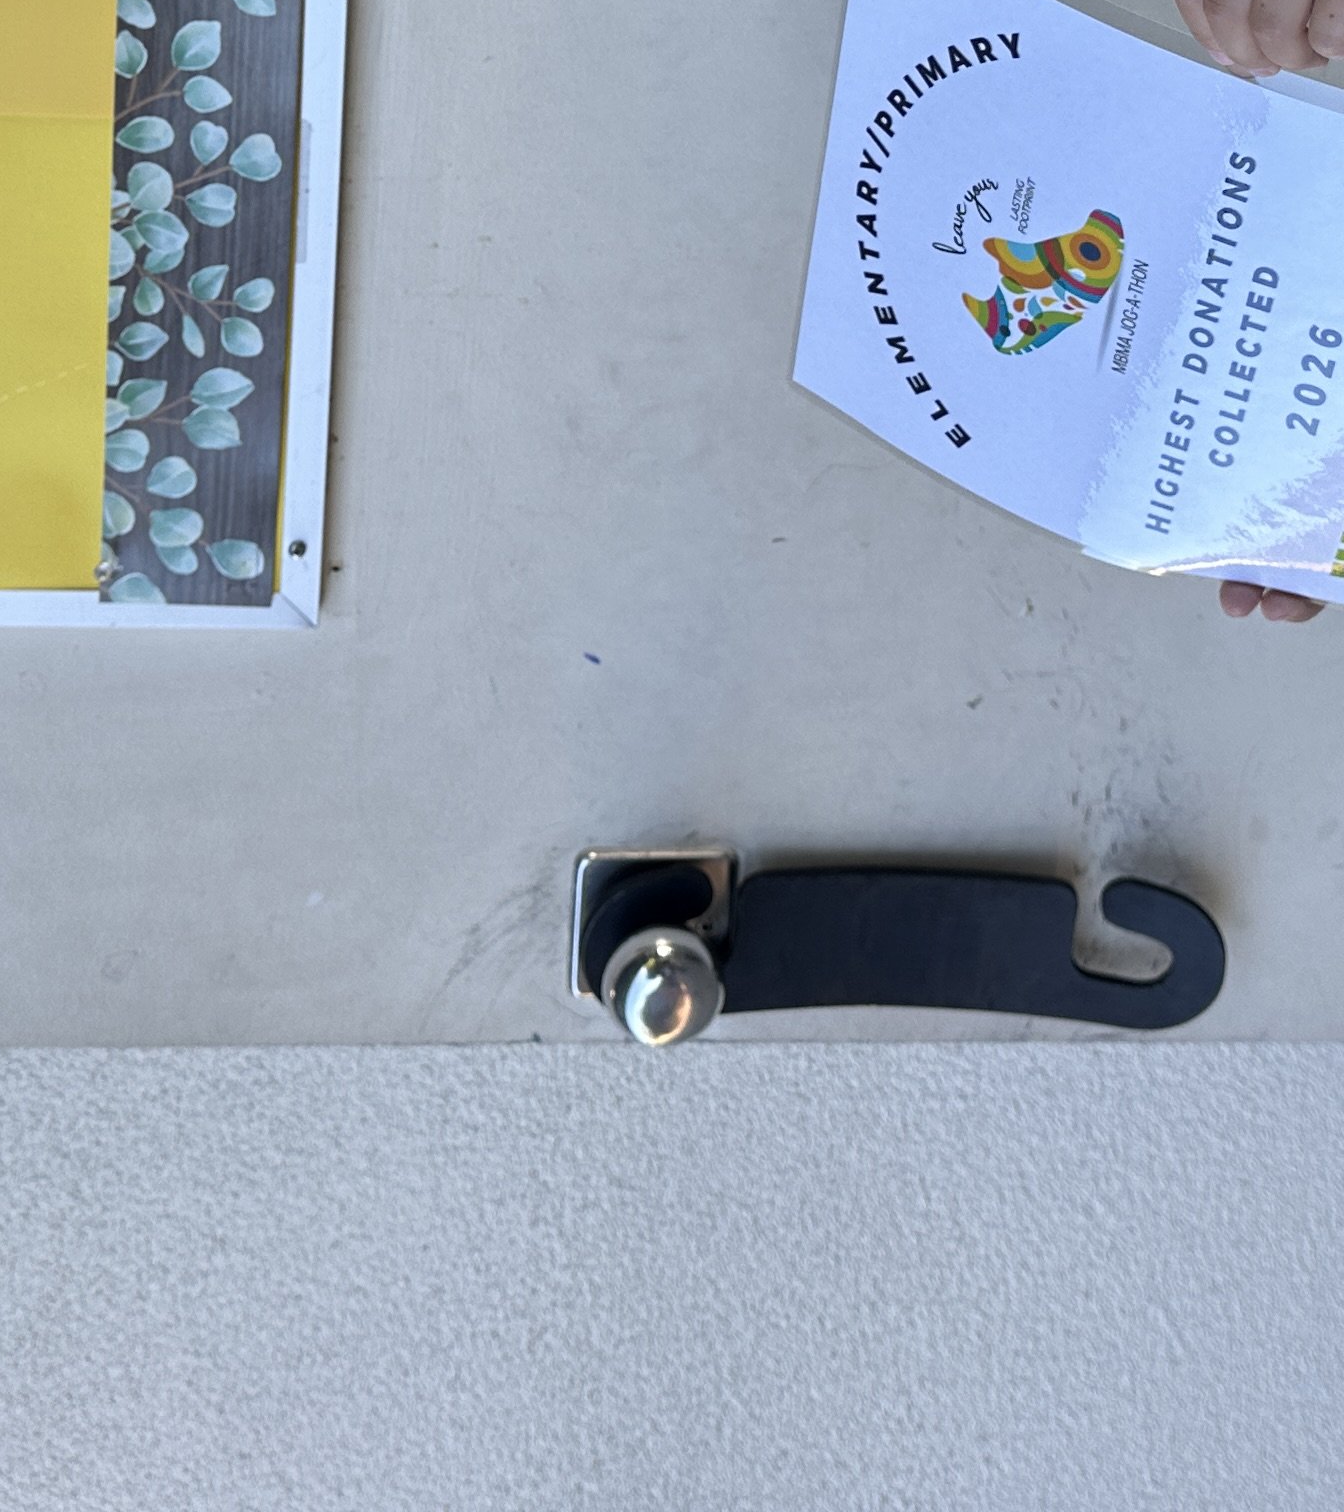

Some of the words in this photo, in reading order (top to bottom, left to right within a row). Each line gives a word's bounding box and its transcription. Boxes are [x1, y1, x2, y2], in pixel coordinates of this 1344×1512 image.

[932, 203, 967, 255] leave
[964, 178, 999, 223] your
[1009, 178, 1025, 221] LASTING
[1017, 176, 1036, 235] FOOTPRINT
[856, 32, 1023, 449] ELEMENTARY/PRIMARY
[1120, 258, 1150, 338] JOG-A-THON
[1111, 336, 1135, 375] MBMA
[1145, 387, 1198, 535] HIGHEST
[1182, 150, 1258, 376] DONATIONS
[1208, 263, 1281, 468] COLLECTED
[1285, 324, 1344, 436] 2026
